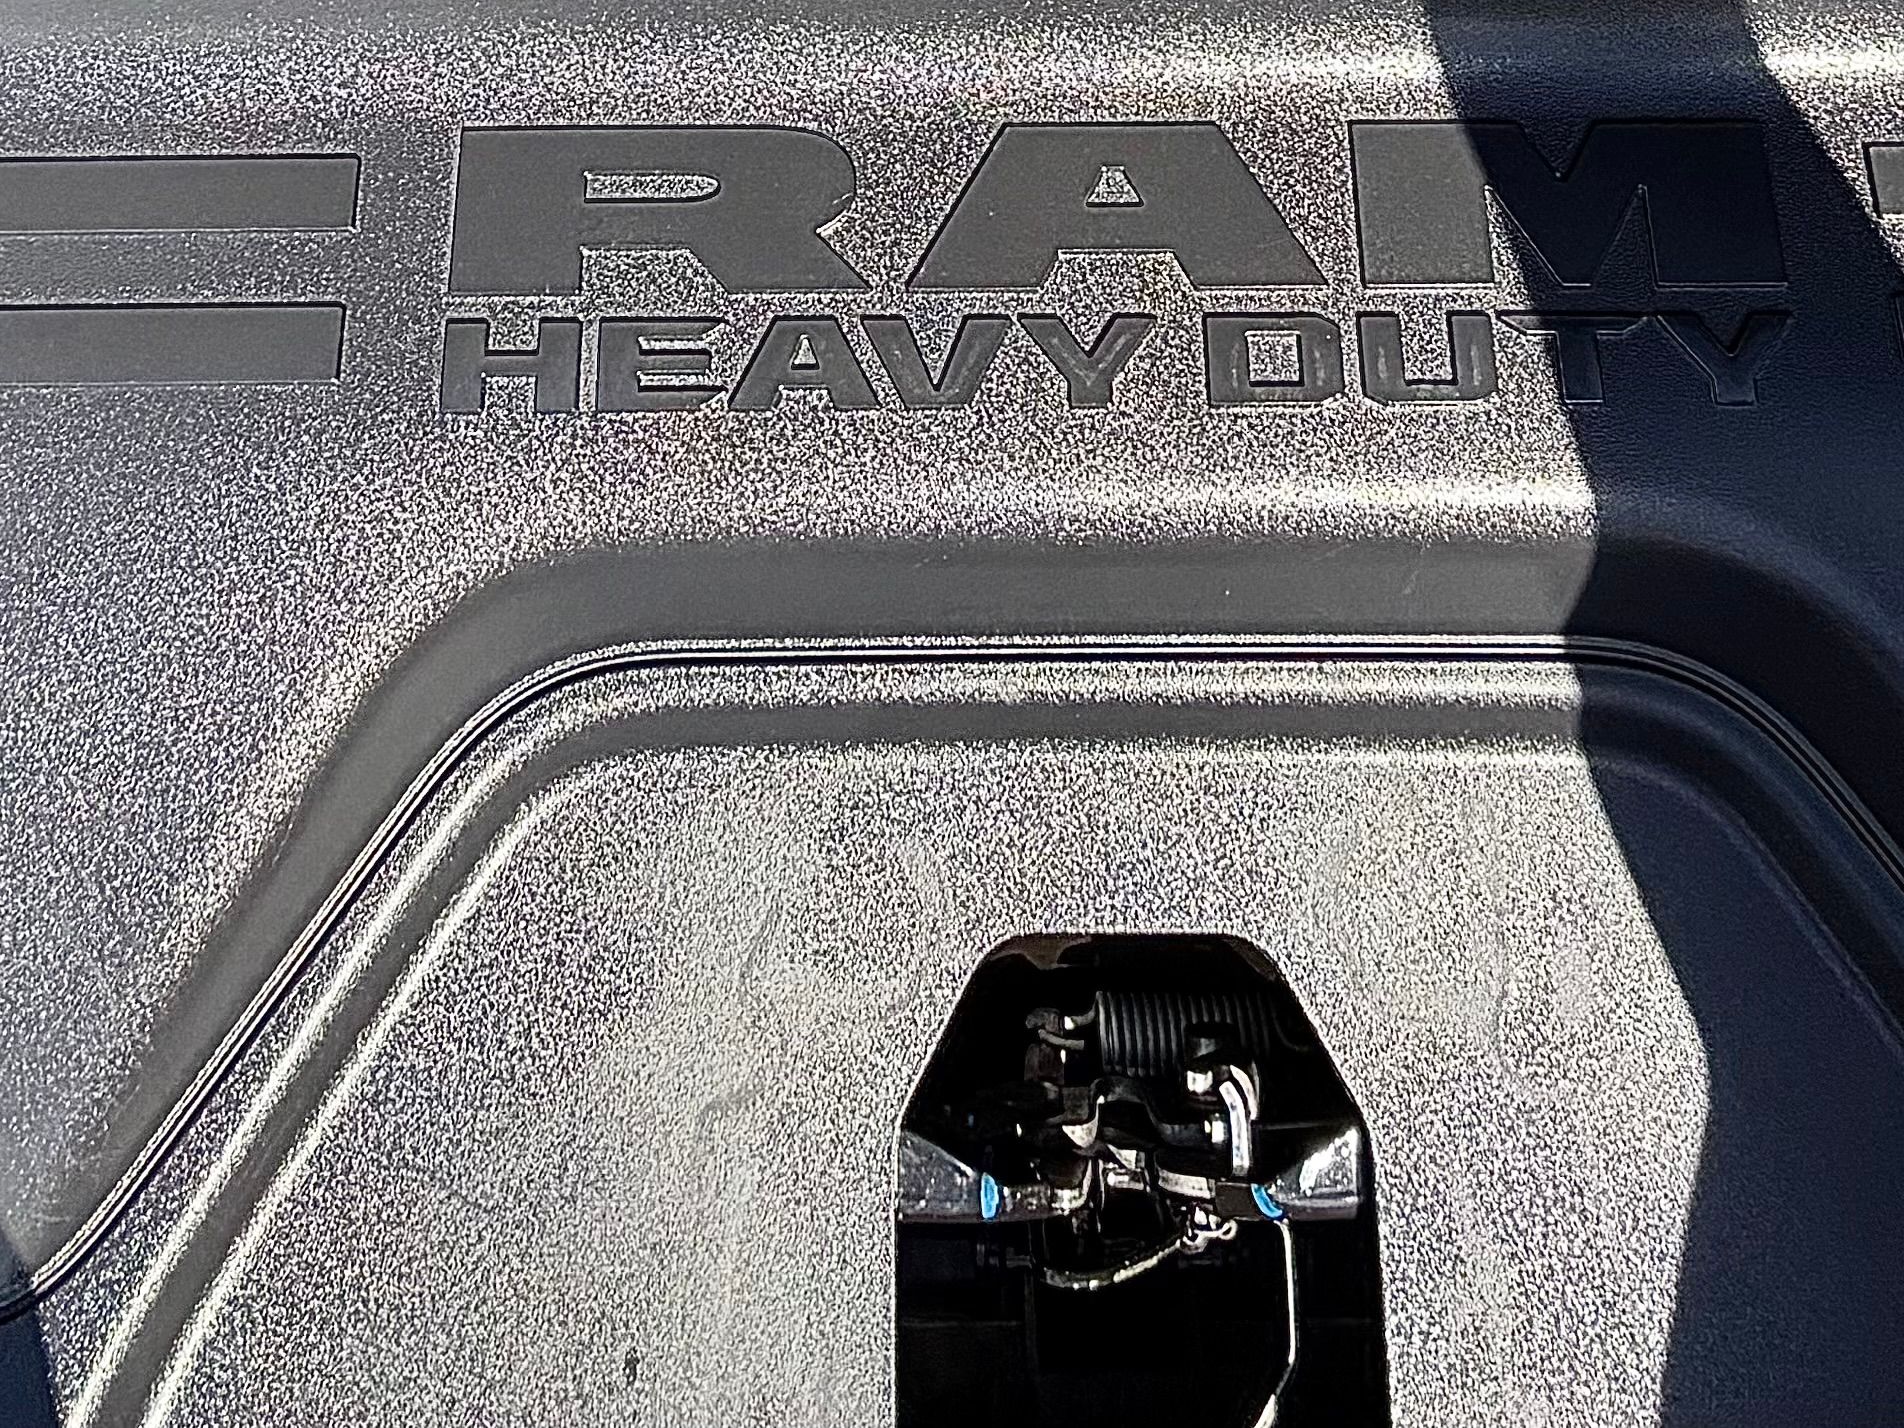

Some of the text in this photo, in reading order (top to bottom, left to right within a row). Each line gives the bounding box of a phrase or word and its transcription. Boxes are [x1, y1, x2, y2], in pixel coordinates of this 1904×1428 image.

[449, 119, 1791, 293] RAM
[443, 312, 1794, 412] HEAVY DUTY
